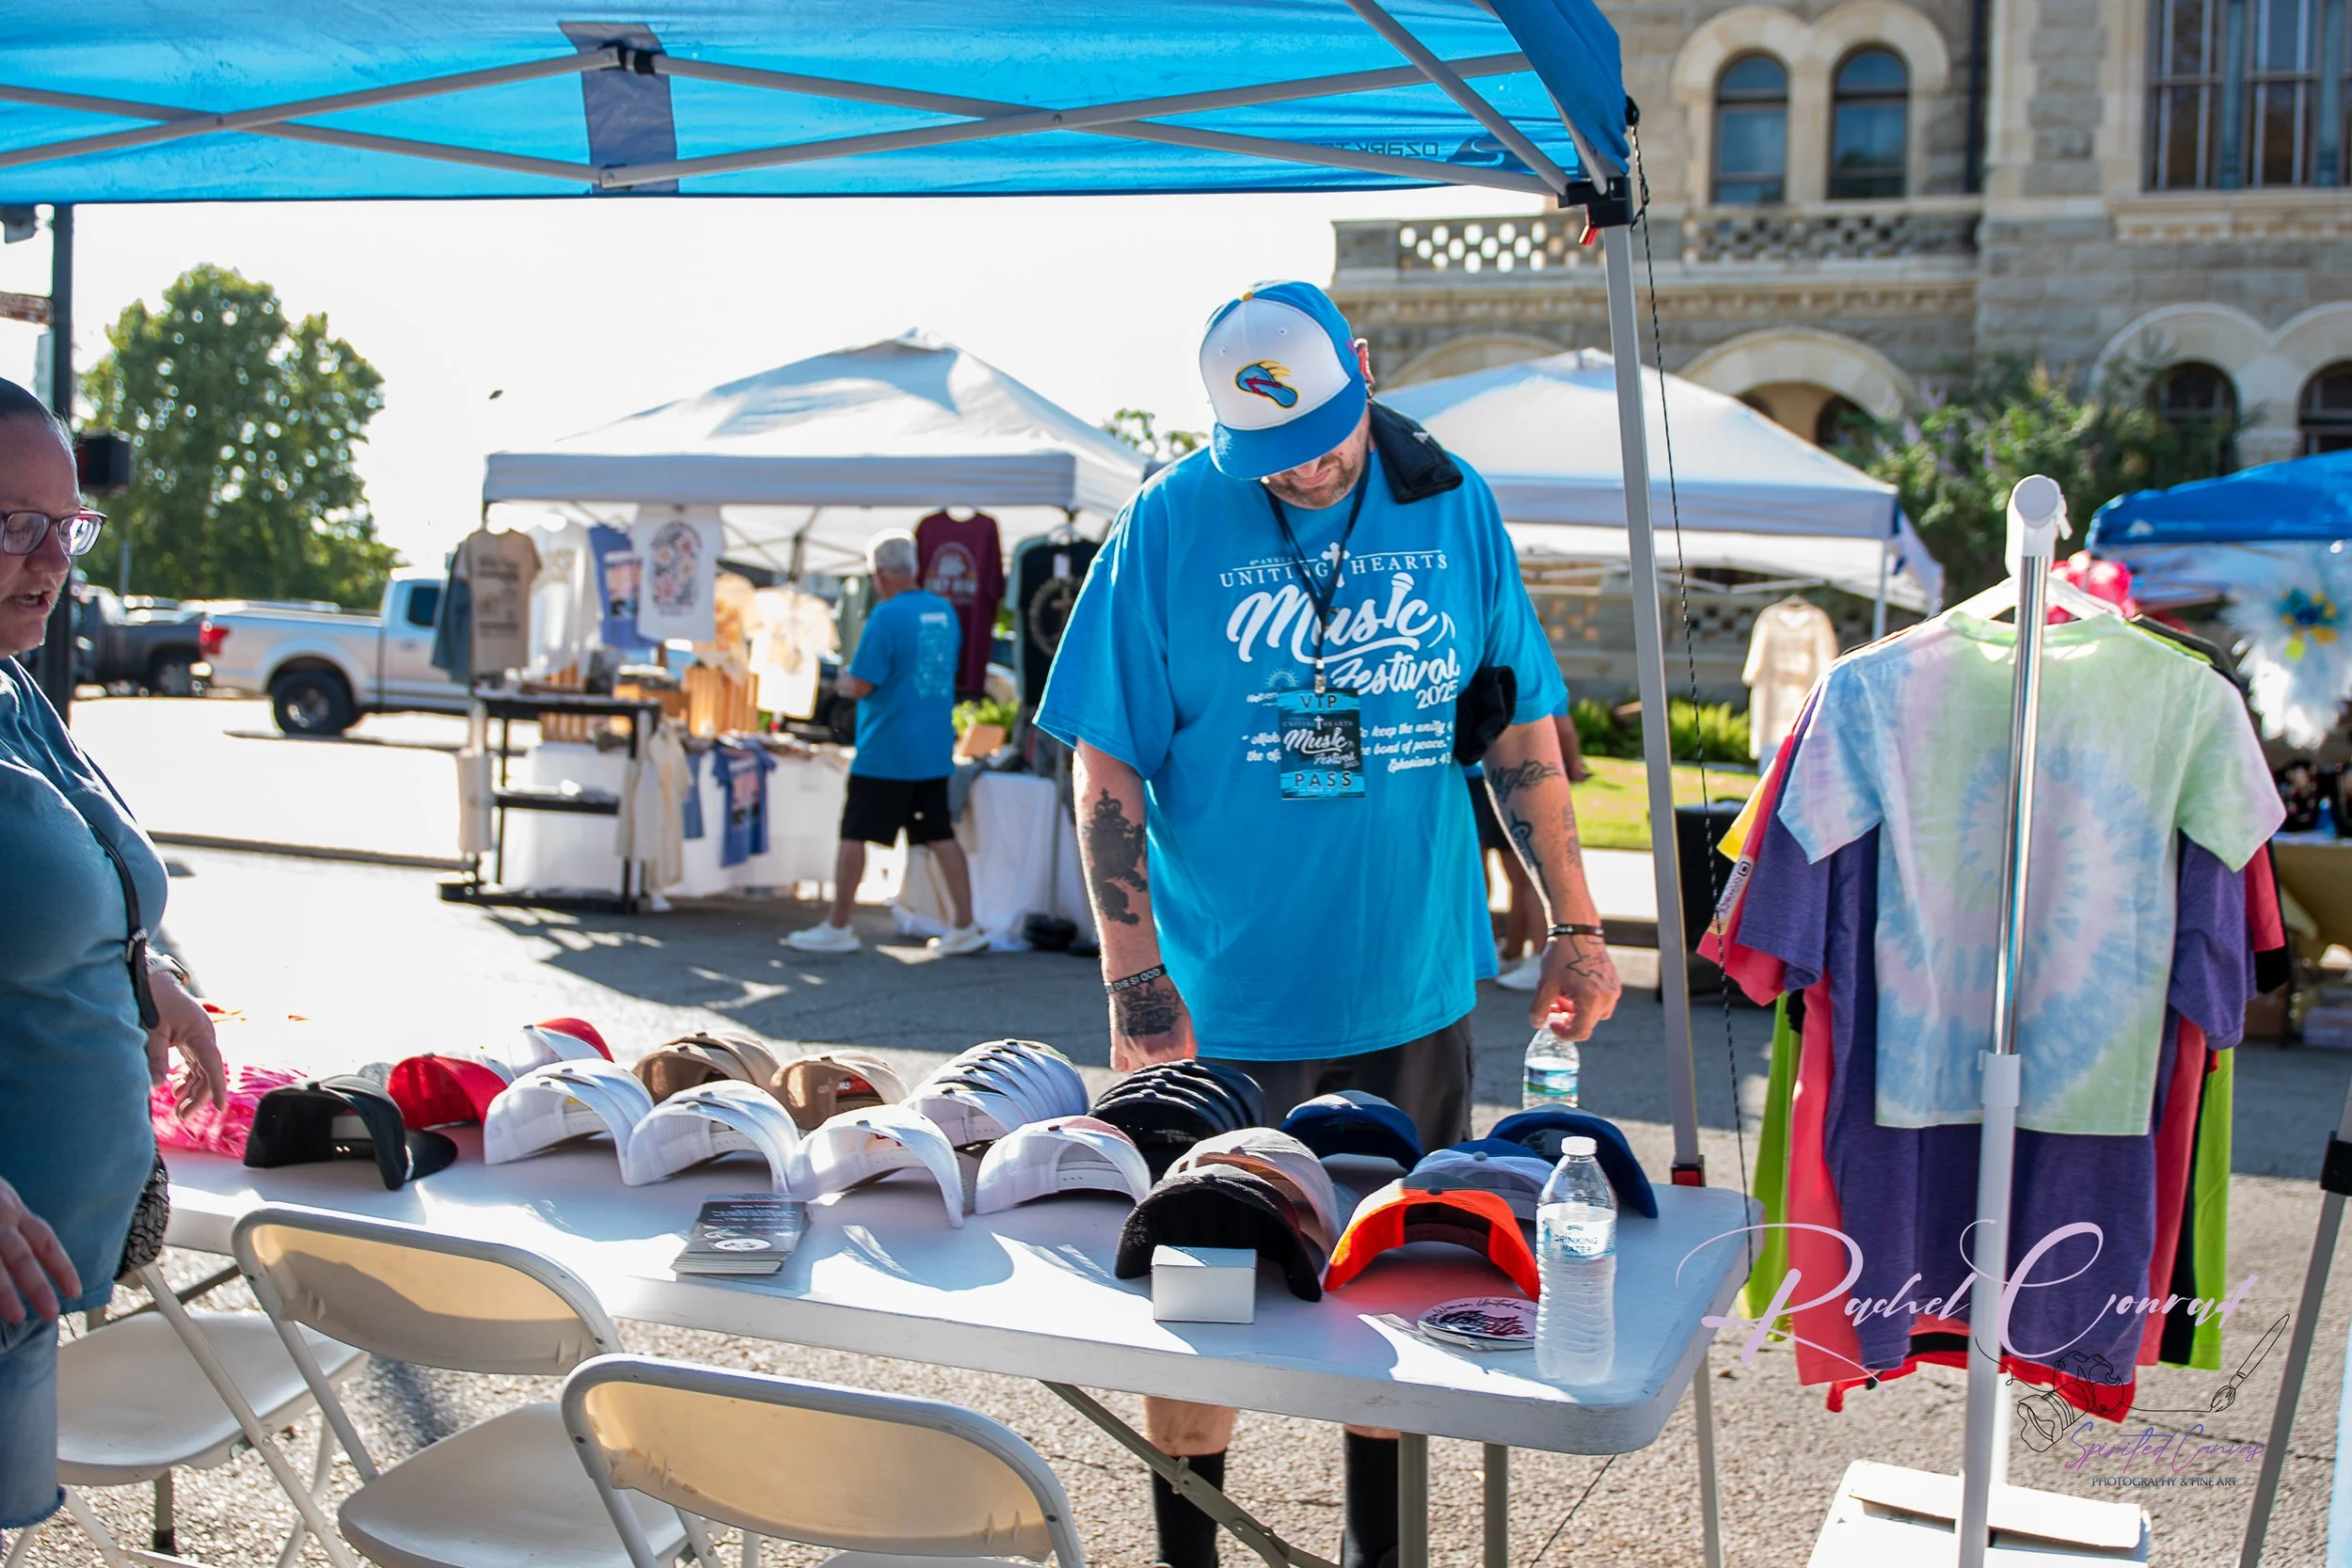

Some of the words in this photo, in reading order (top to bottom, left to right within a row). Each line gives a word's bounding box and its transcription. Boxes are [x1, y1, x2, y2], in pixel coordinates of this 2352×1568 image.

[1351, 553, 1449, 574] HEARTS
[1226, 572, 1438, 662] Music
[1330, 647, 1460, 695] Festival
[1299, 694, 1337, 708] VIP
[1415, 679, 1459, 709] 2025
[1283, 727, 1347, 753] Music
[1294, 772, 1351, 786] PASS
[1129, 976, 1140, 985] IS
[1139, 968, 1161, 981] GOD
[1554, 1234, 1598, 1244] DRINKING
[1560, 1244, 1592, 1255] WATER
